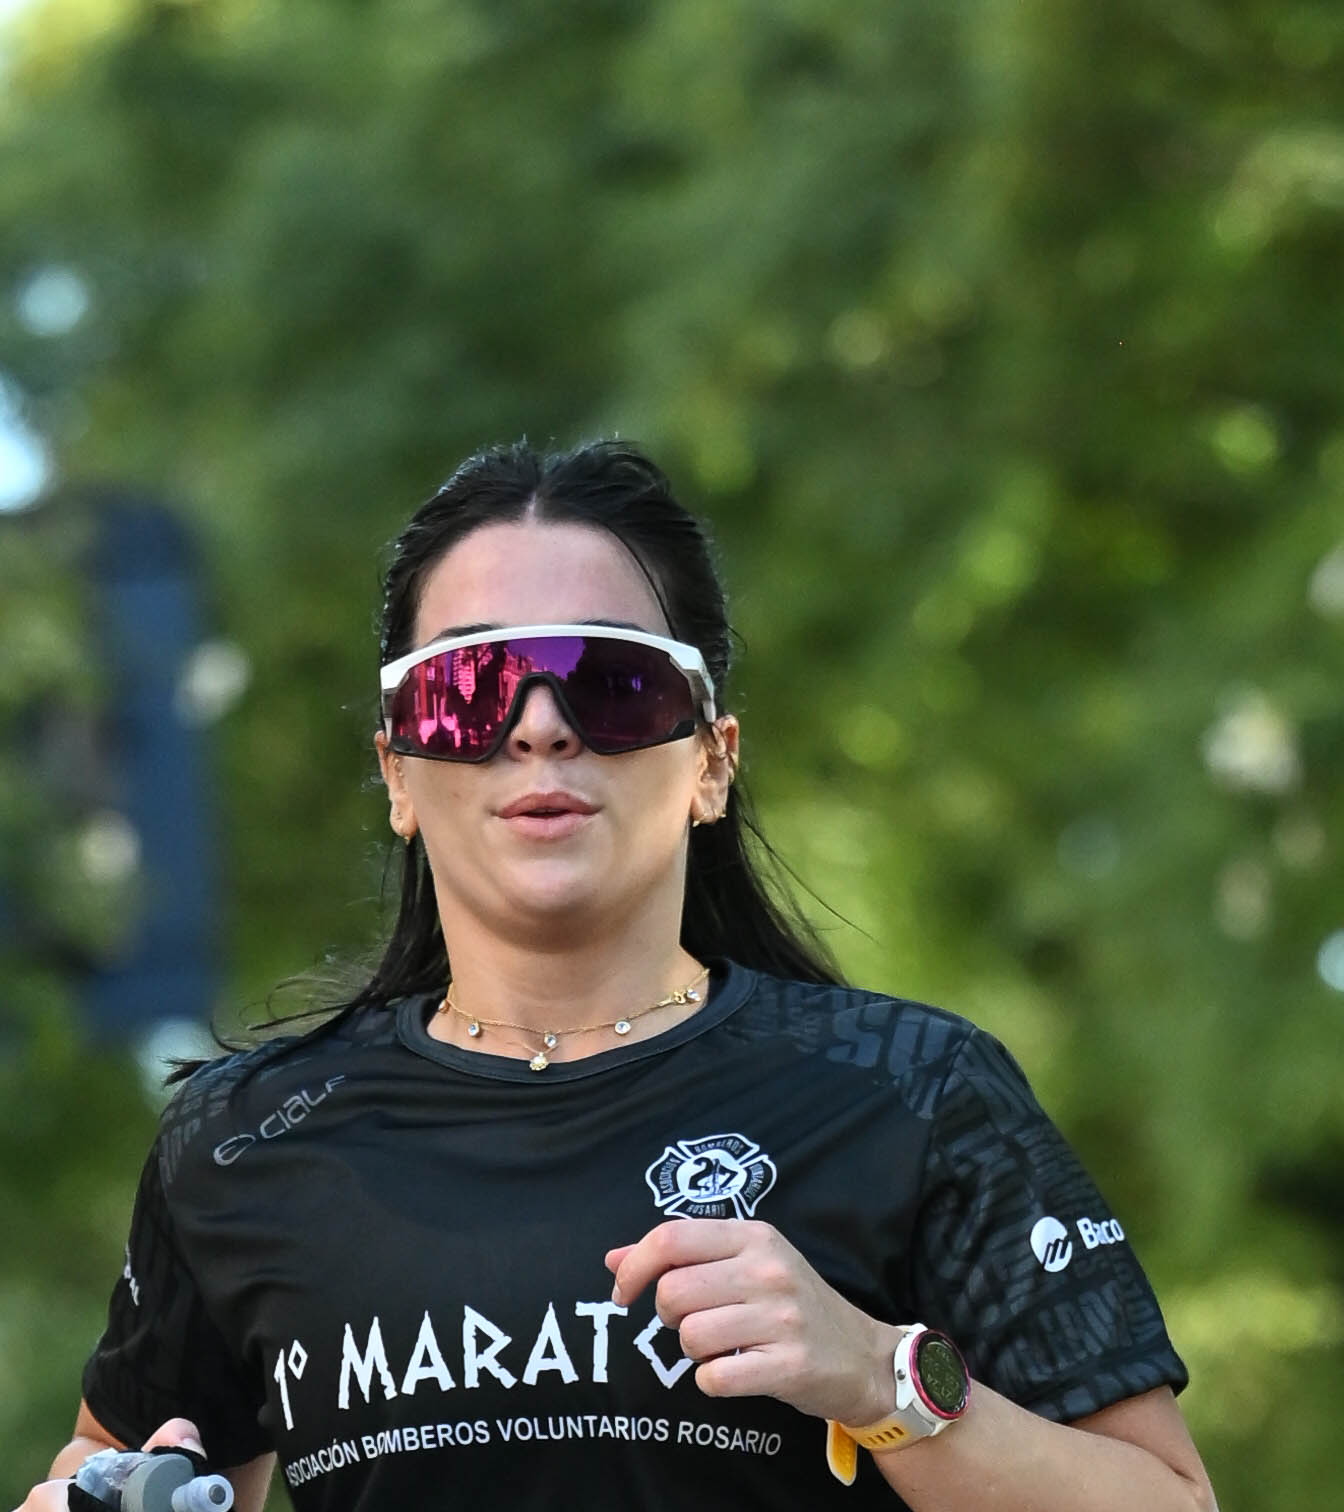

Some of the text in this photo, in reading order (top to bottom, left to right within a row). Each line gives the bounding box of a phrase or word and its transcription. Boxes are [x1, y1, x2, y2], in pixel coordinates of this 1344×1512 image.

[687, 1156, 739, 1191] 27
[360, 1419, 491, 1460] BOMBEROS
[496, 1414, 670, 1443] VOLUNTARIOS
[676, 1420, 782, 1456] ROSARIO
